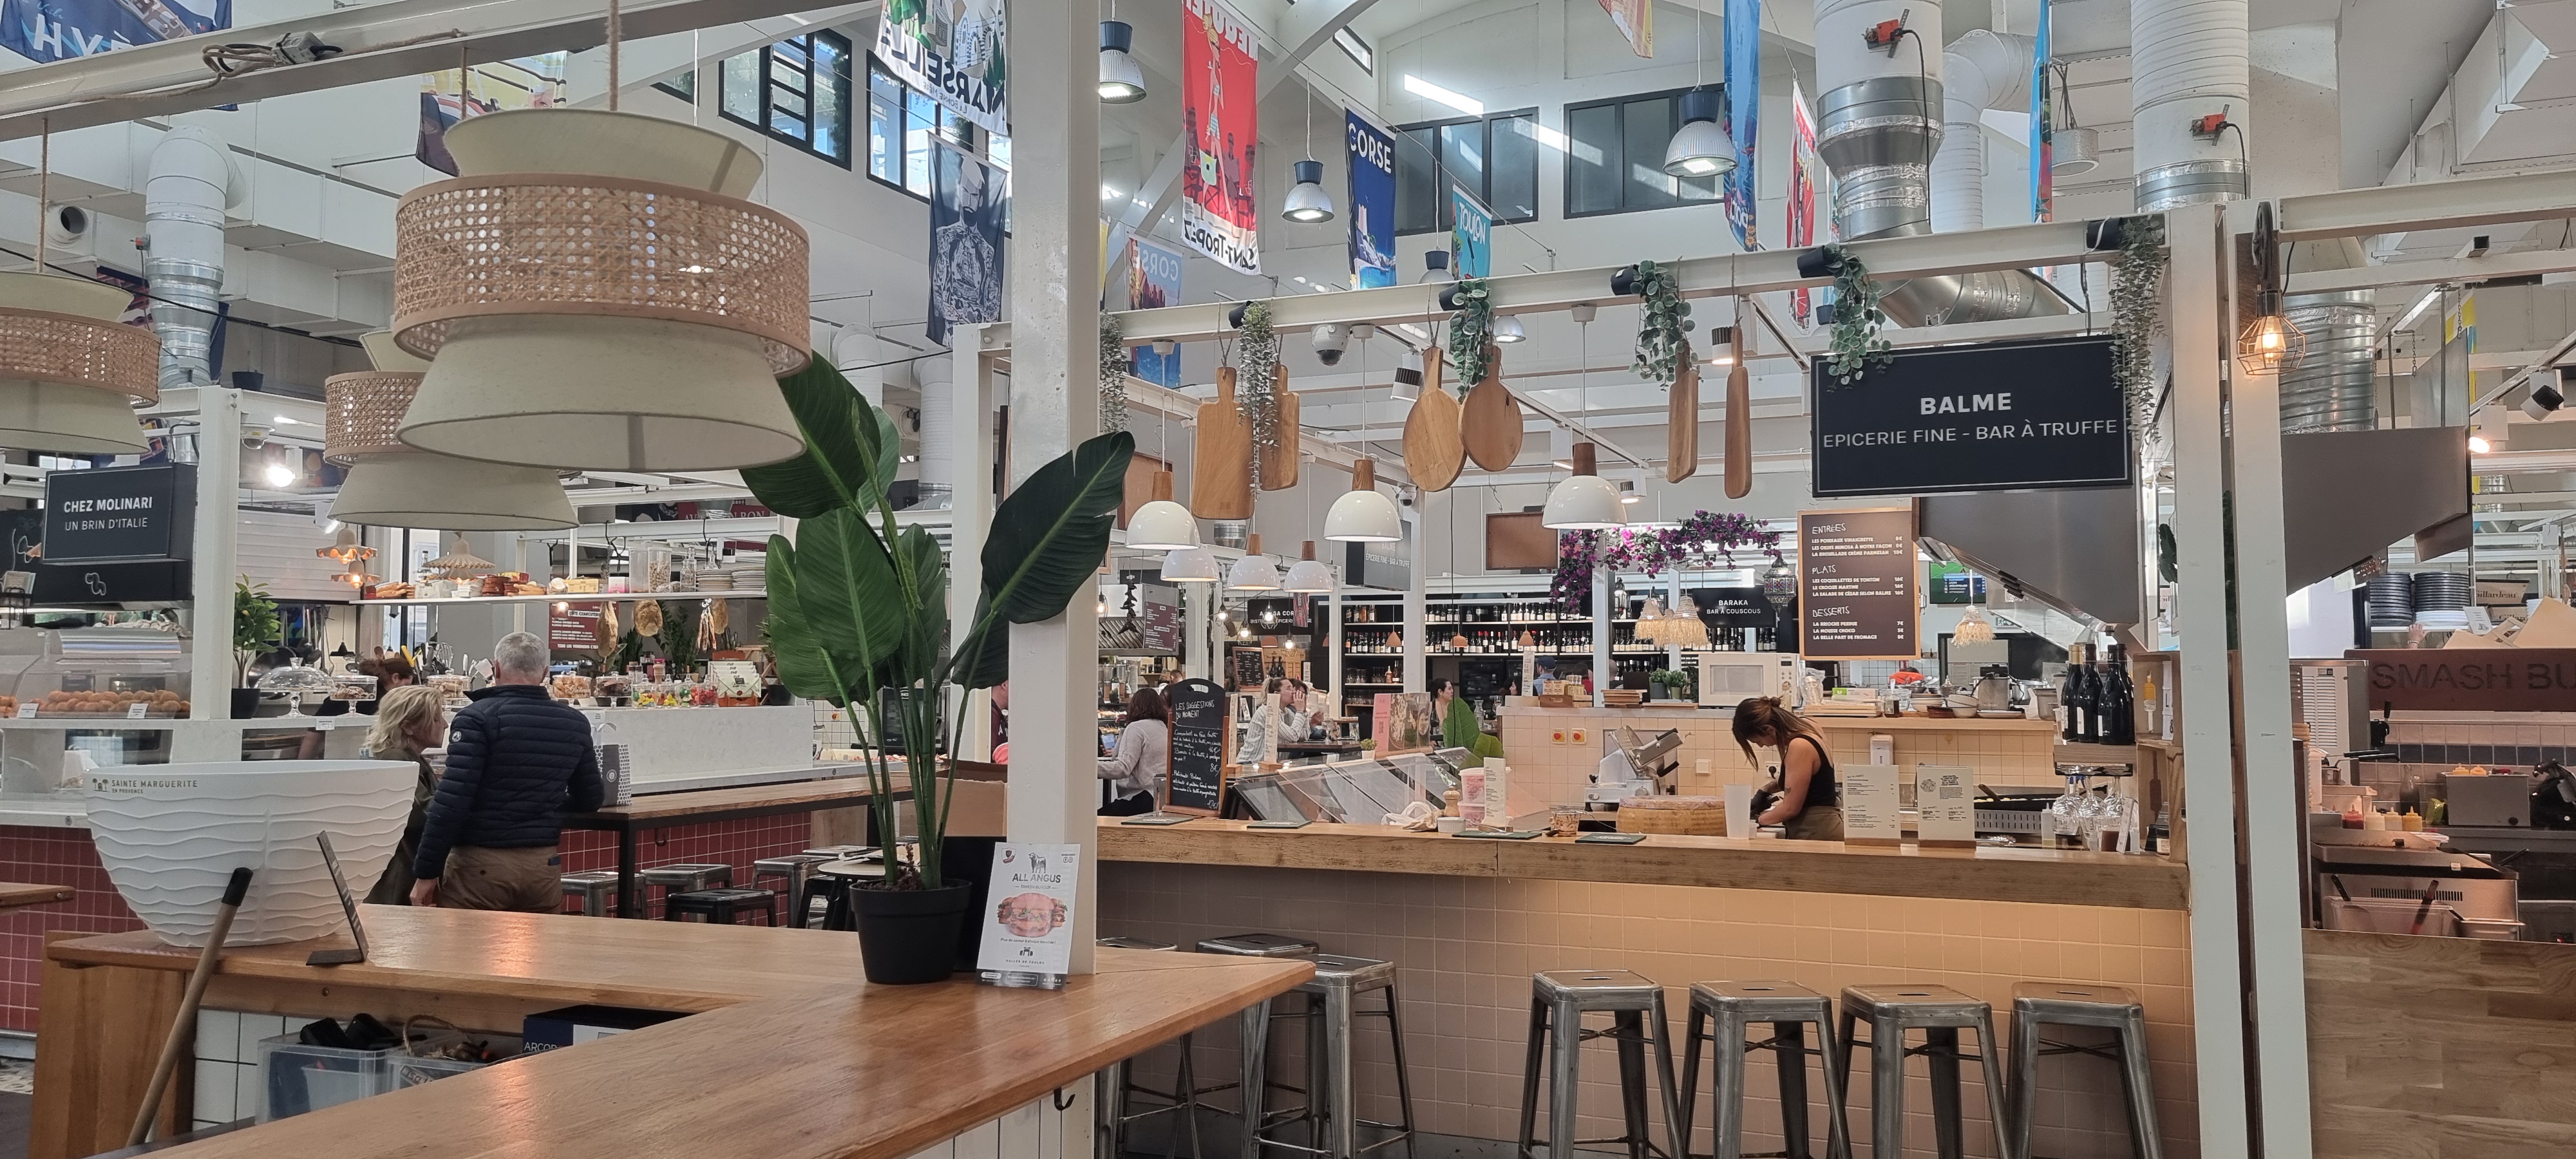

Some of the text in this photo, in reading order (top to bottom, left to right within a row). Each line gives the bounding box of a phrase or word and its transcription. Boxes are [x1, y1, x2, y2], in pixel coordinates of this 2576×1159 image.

[1348, 122, 1392, 173] CORSE
[1459, 202, 1486, 245] TOULON
[1920, 392, 2012, 415] BALME
[1823, 430, 1907, 448] EPICERIE
[1913, 428, 1956, 443] FINE
[1976, 424, 2015, 440] BAR
[2021, 419, 2034, 438] À
[2038, 419, 2117, 437] TRUFFE
[64, 496, 153, 513] CHEZ MOLINARI
[65, 517, 148, 531] UN BRIN D'ITALIE
[1812, 522, 1846, 535] ENTRÉES
[1812, 564, 1836, 574] PLATS
[1812, 605, 1850, 617] DESSERTS
[2372, 663, 2514, 690] SMASH
[1175, 699, 1215, 711] LES SUGGESTIONS
[1012, 873, 1061, 883] ALL ANGUS
